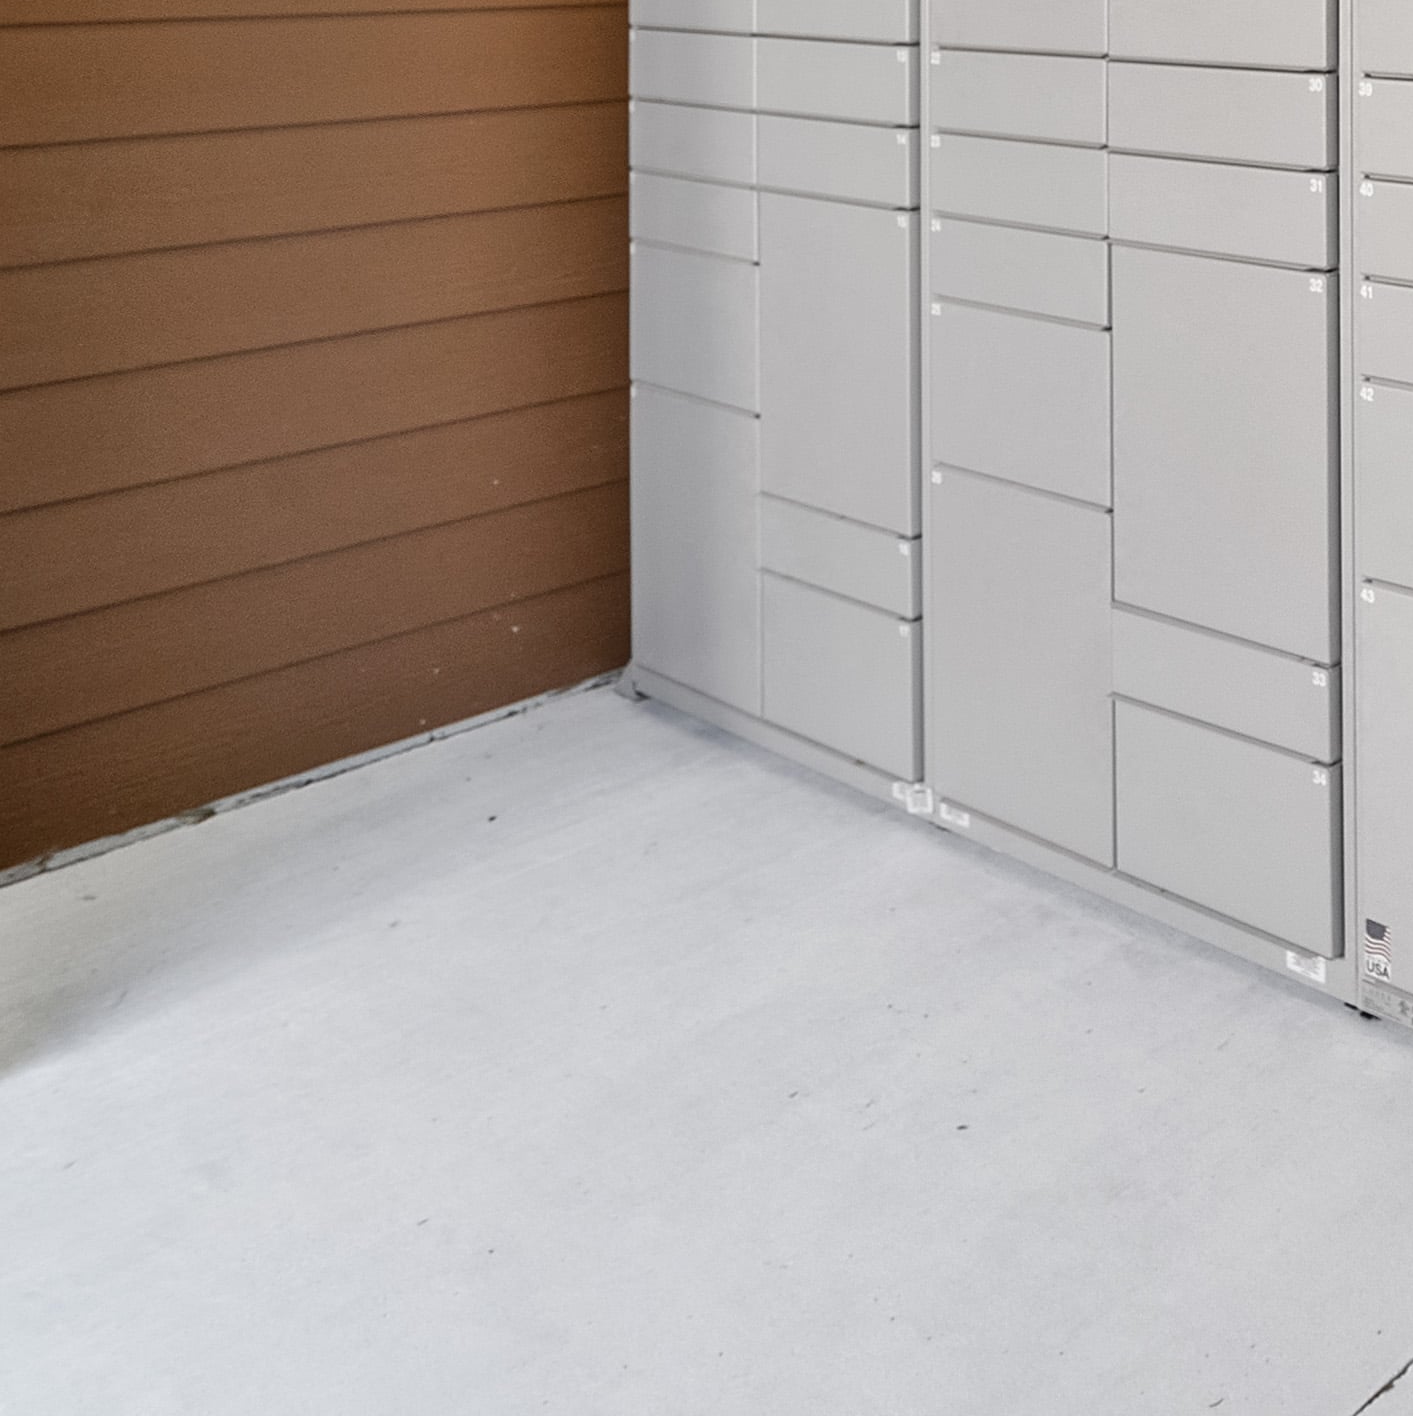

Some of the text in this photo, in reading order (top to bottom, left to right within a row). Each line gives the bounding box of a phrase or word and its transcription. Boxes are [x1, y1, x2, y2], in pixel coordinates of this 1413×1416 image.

[1308, 78, 1323, 92] 30
[1310, 178, 1322, 193] 31
[1309, 278, 1323, 293] 32
[1312, 671, 1326, 687] 33
[1366, 958, 1391, 980] USA
